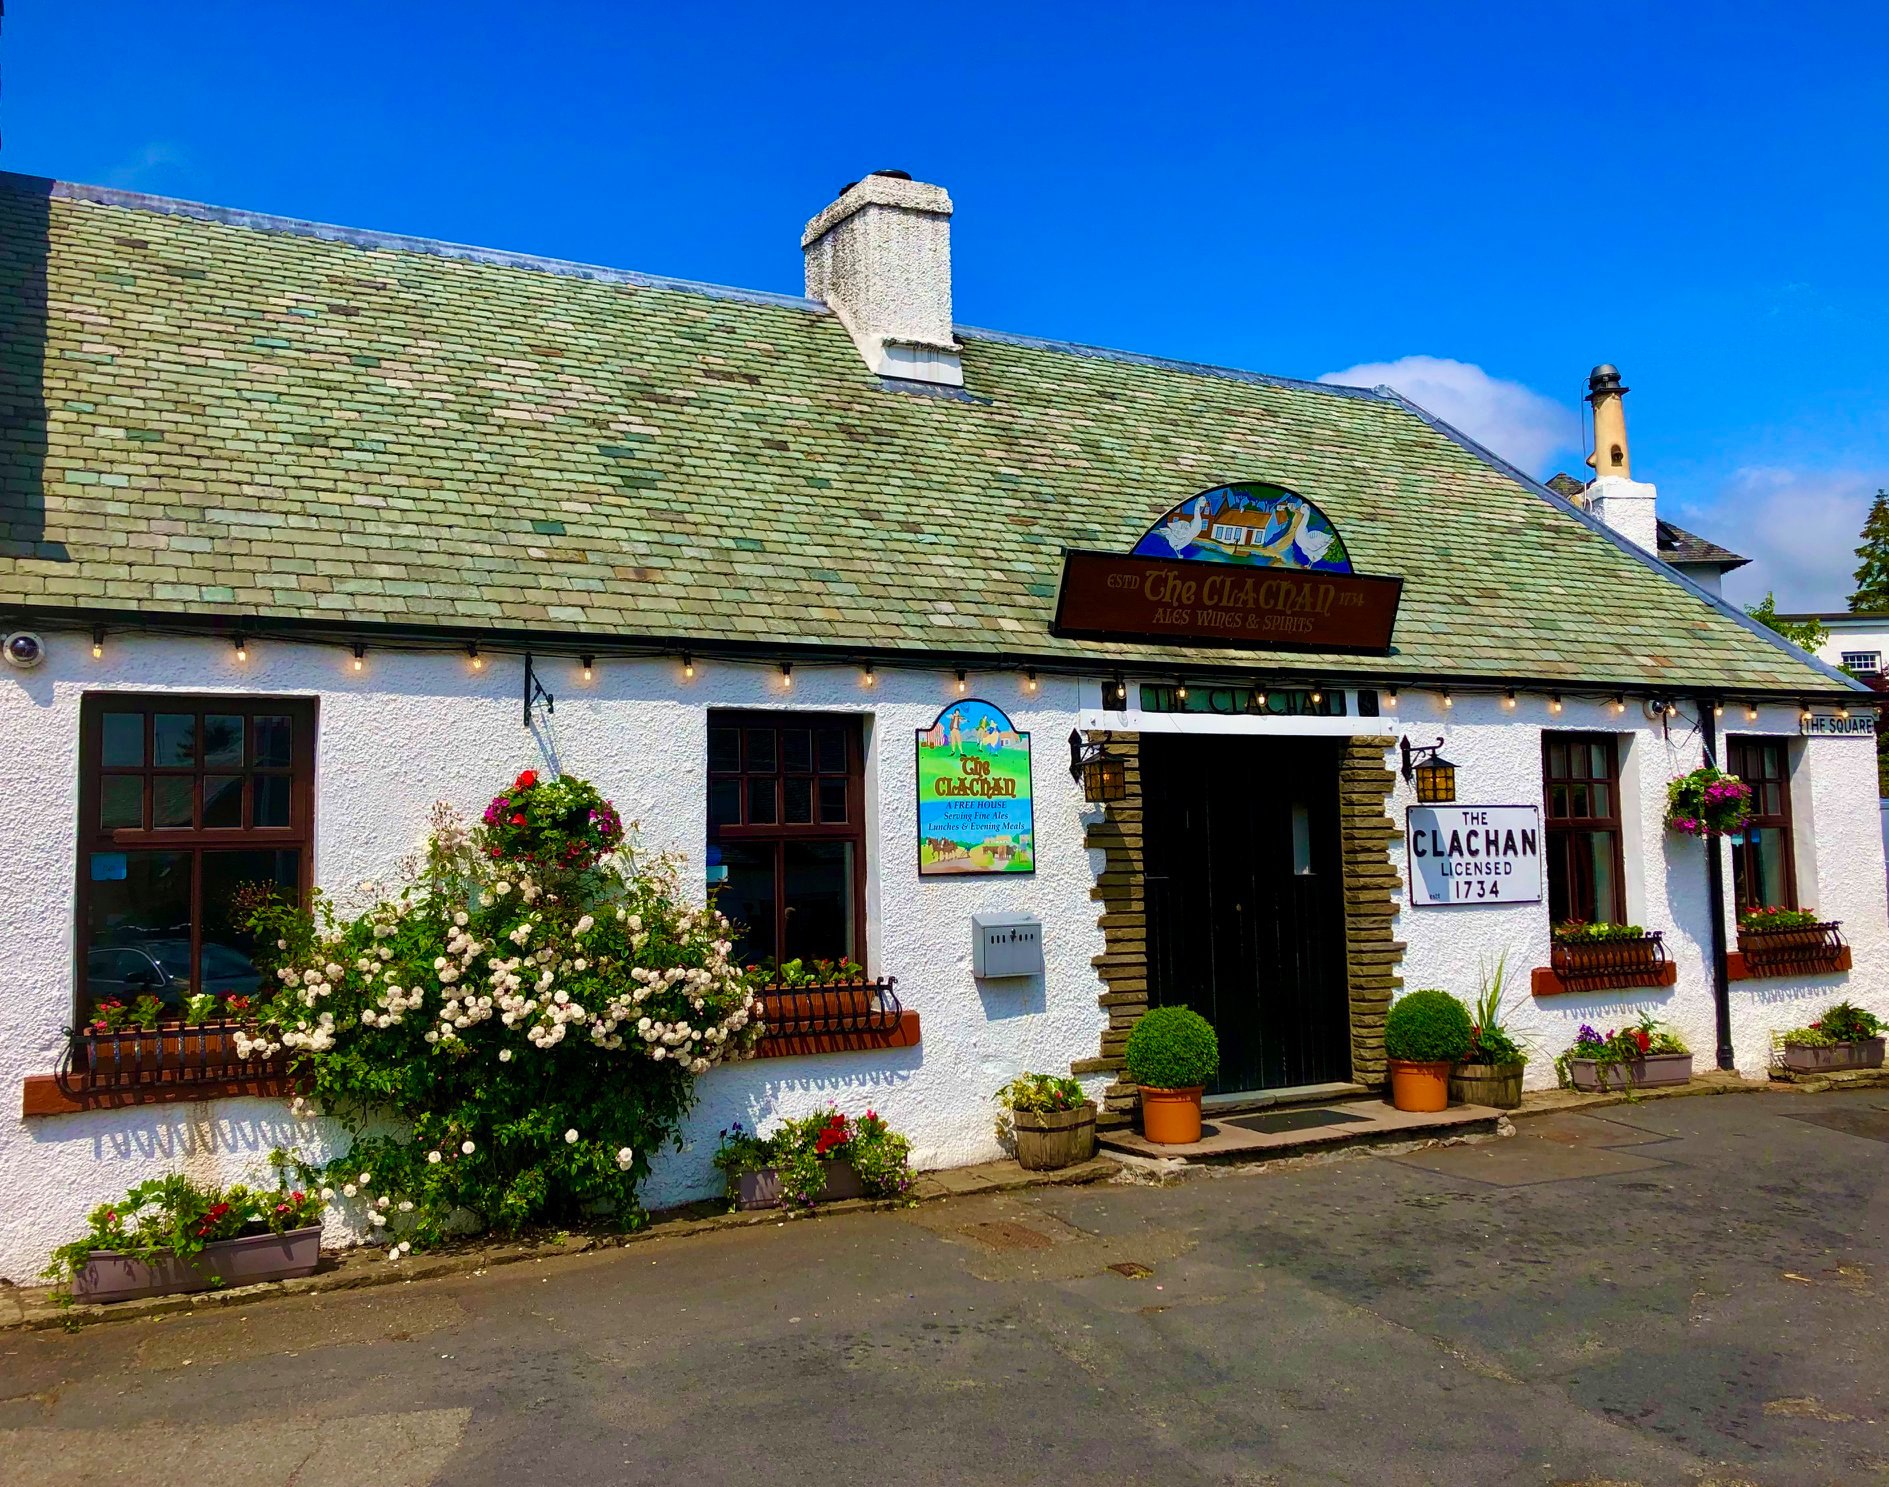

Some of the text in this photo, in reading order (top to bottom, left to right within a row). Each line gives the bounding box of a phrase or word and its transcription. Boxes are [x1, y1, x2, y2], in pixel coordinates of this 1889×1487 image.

[1106, 568, 1365, 616] ESTD The CLACHAN 1734
[1152, 608, 1315, 633] ALES WINES & SPIRITS
[1829, 718, 1873, 733] SQUARE
[960, 756, 990, 778] The
[934, 777, 1016, 799] CLACHAN
[945, 800, 1007, 809] A FREE HOUSE
[944, 812, 1009, 821] Serving Fine Ales
[1462, 812, 1488, 825] THE
[928, 822, 1025, 832] Lunches & Evening Meals
[1412, 829, 1537, 858] CLACHAN
[1441, 862, 1512, 877] LICENSED
[1455, 880, 1500, 899] 1734
